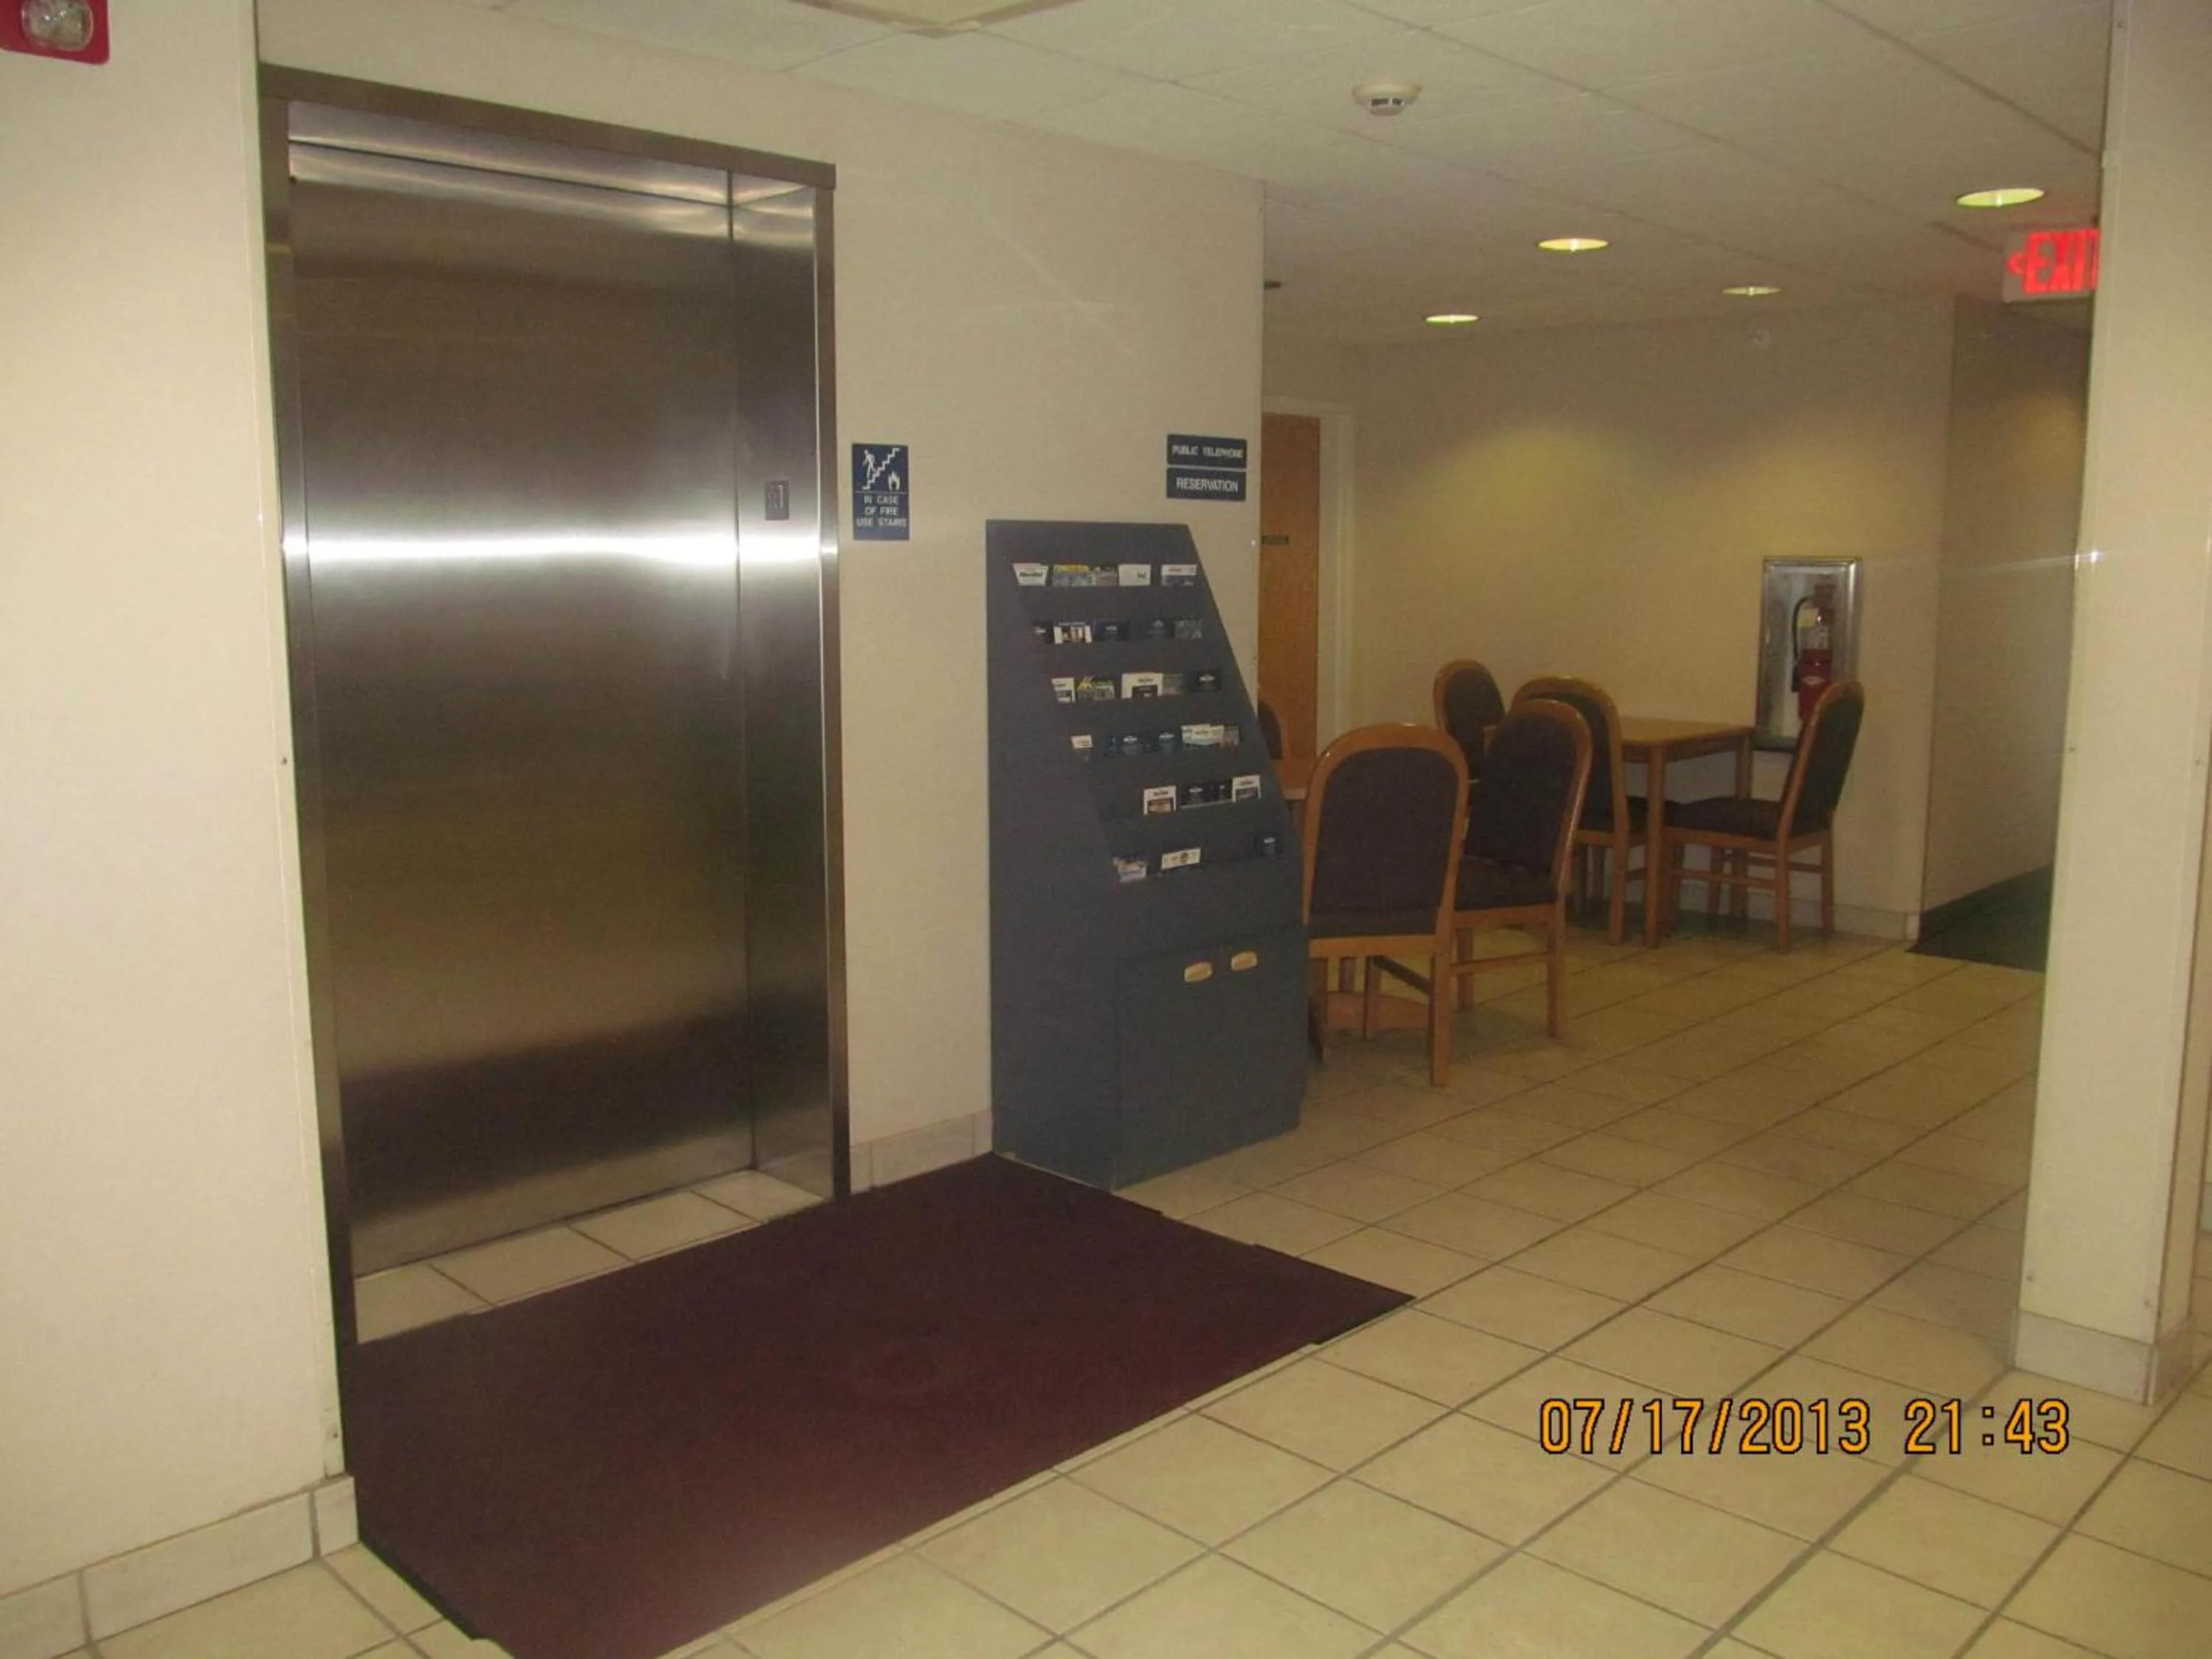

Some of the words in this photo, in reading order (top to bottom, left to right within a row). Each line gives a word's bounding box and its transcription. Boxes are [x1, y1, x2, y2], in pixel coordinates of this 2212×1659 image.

[1172, 445, 1198, 456] PUBLIC
[1203, 448, 1244, 459] TELEPHONE
[1176, 477, 1239, 493] RESERVATION
[863, 495, 872, 504] IN
[877, 495, 898, 505] CASE
[865, 507, 876, 515] OF
[880, 507, 898, 516] FIRE
[856, 518, 873, 527] USE
[878, 518, 907, 528] STAIRS
